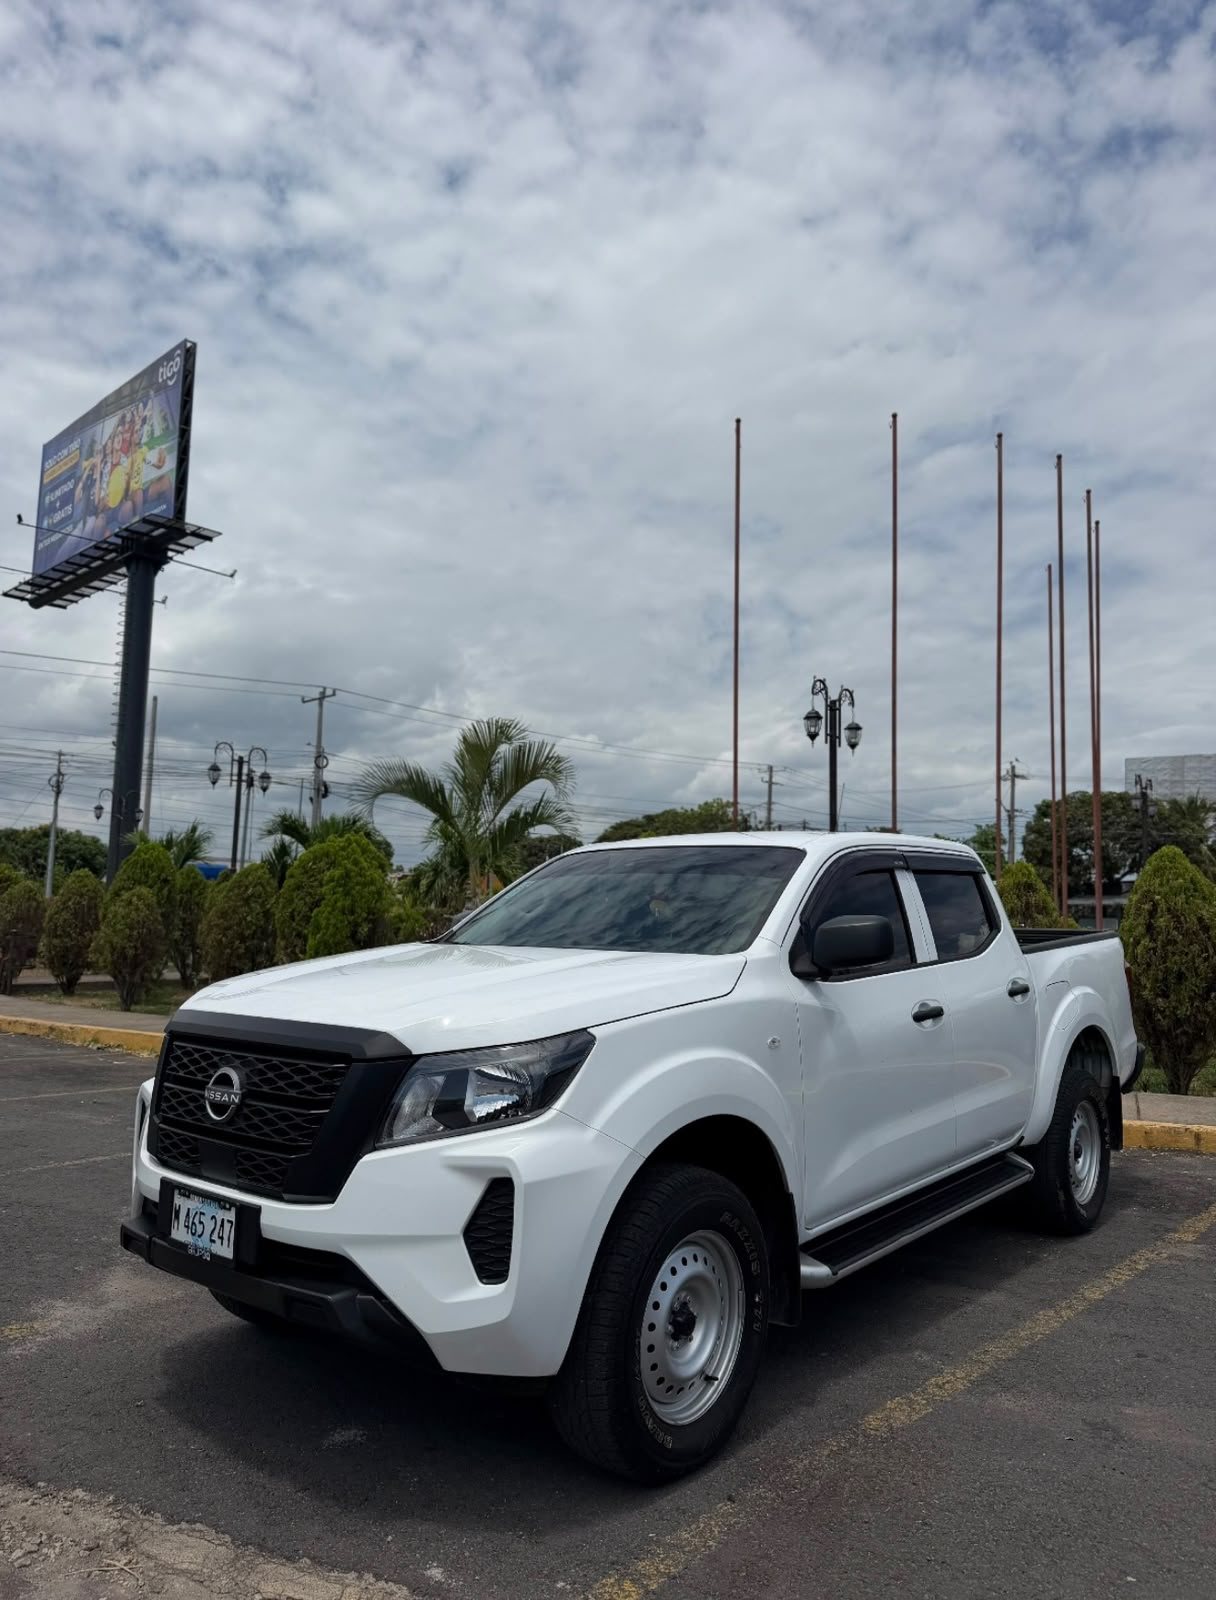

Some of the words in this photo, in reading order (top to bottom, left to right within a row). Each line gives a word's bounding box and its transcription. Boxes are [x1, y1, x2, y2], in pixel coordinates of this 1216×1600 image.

[206, 1089, 239, 1103] ISSAN
[184, 1207, 206, 1238] 465
[209, 1215, 234, 1248] 247
